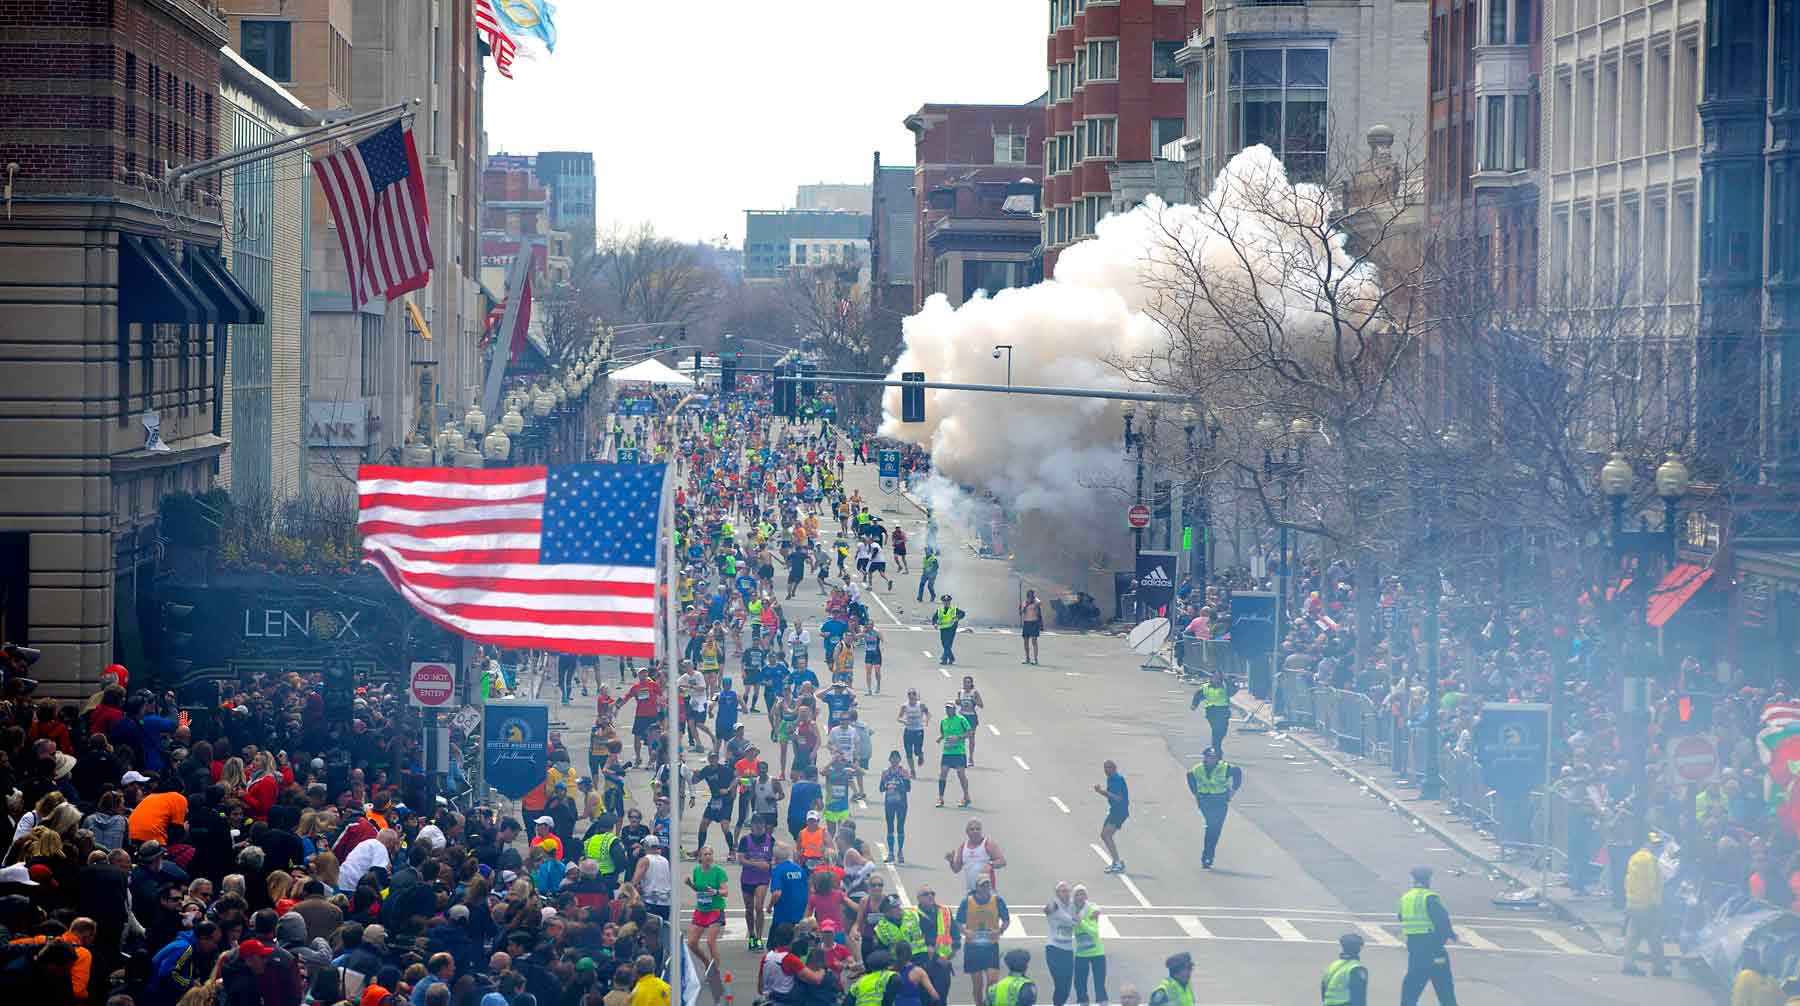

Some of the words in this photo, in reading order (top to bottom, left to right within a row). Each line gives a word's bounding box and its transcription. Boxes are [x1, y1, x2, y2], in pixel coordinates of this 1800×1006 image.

[622, 452, 633, 461] 26
[884, 454, 895, 462] 26
[1141, 579, 1173, 587] adidas
[245, 608, 361, 640] LENOX
[418, 673, 430, 681] DO
[432, 673, 449, 681] NOT
[420, 689, 446, 697] ENTER
